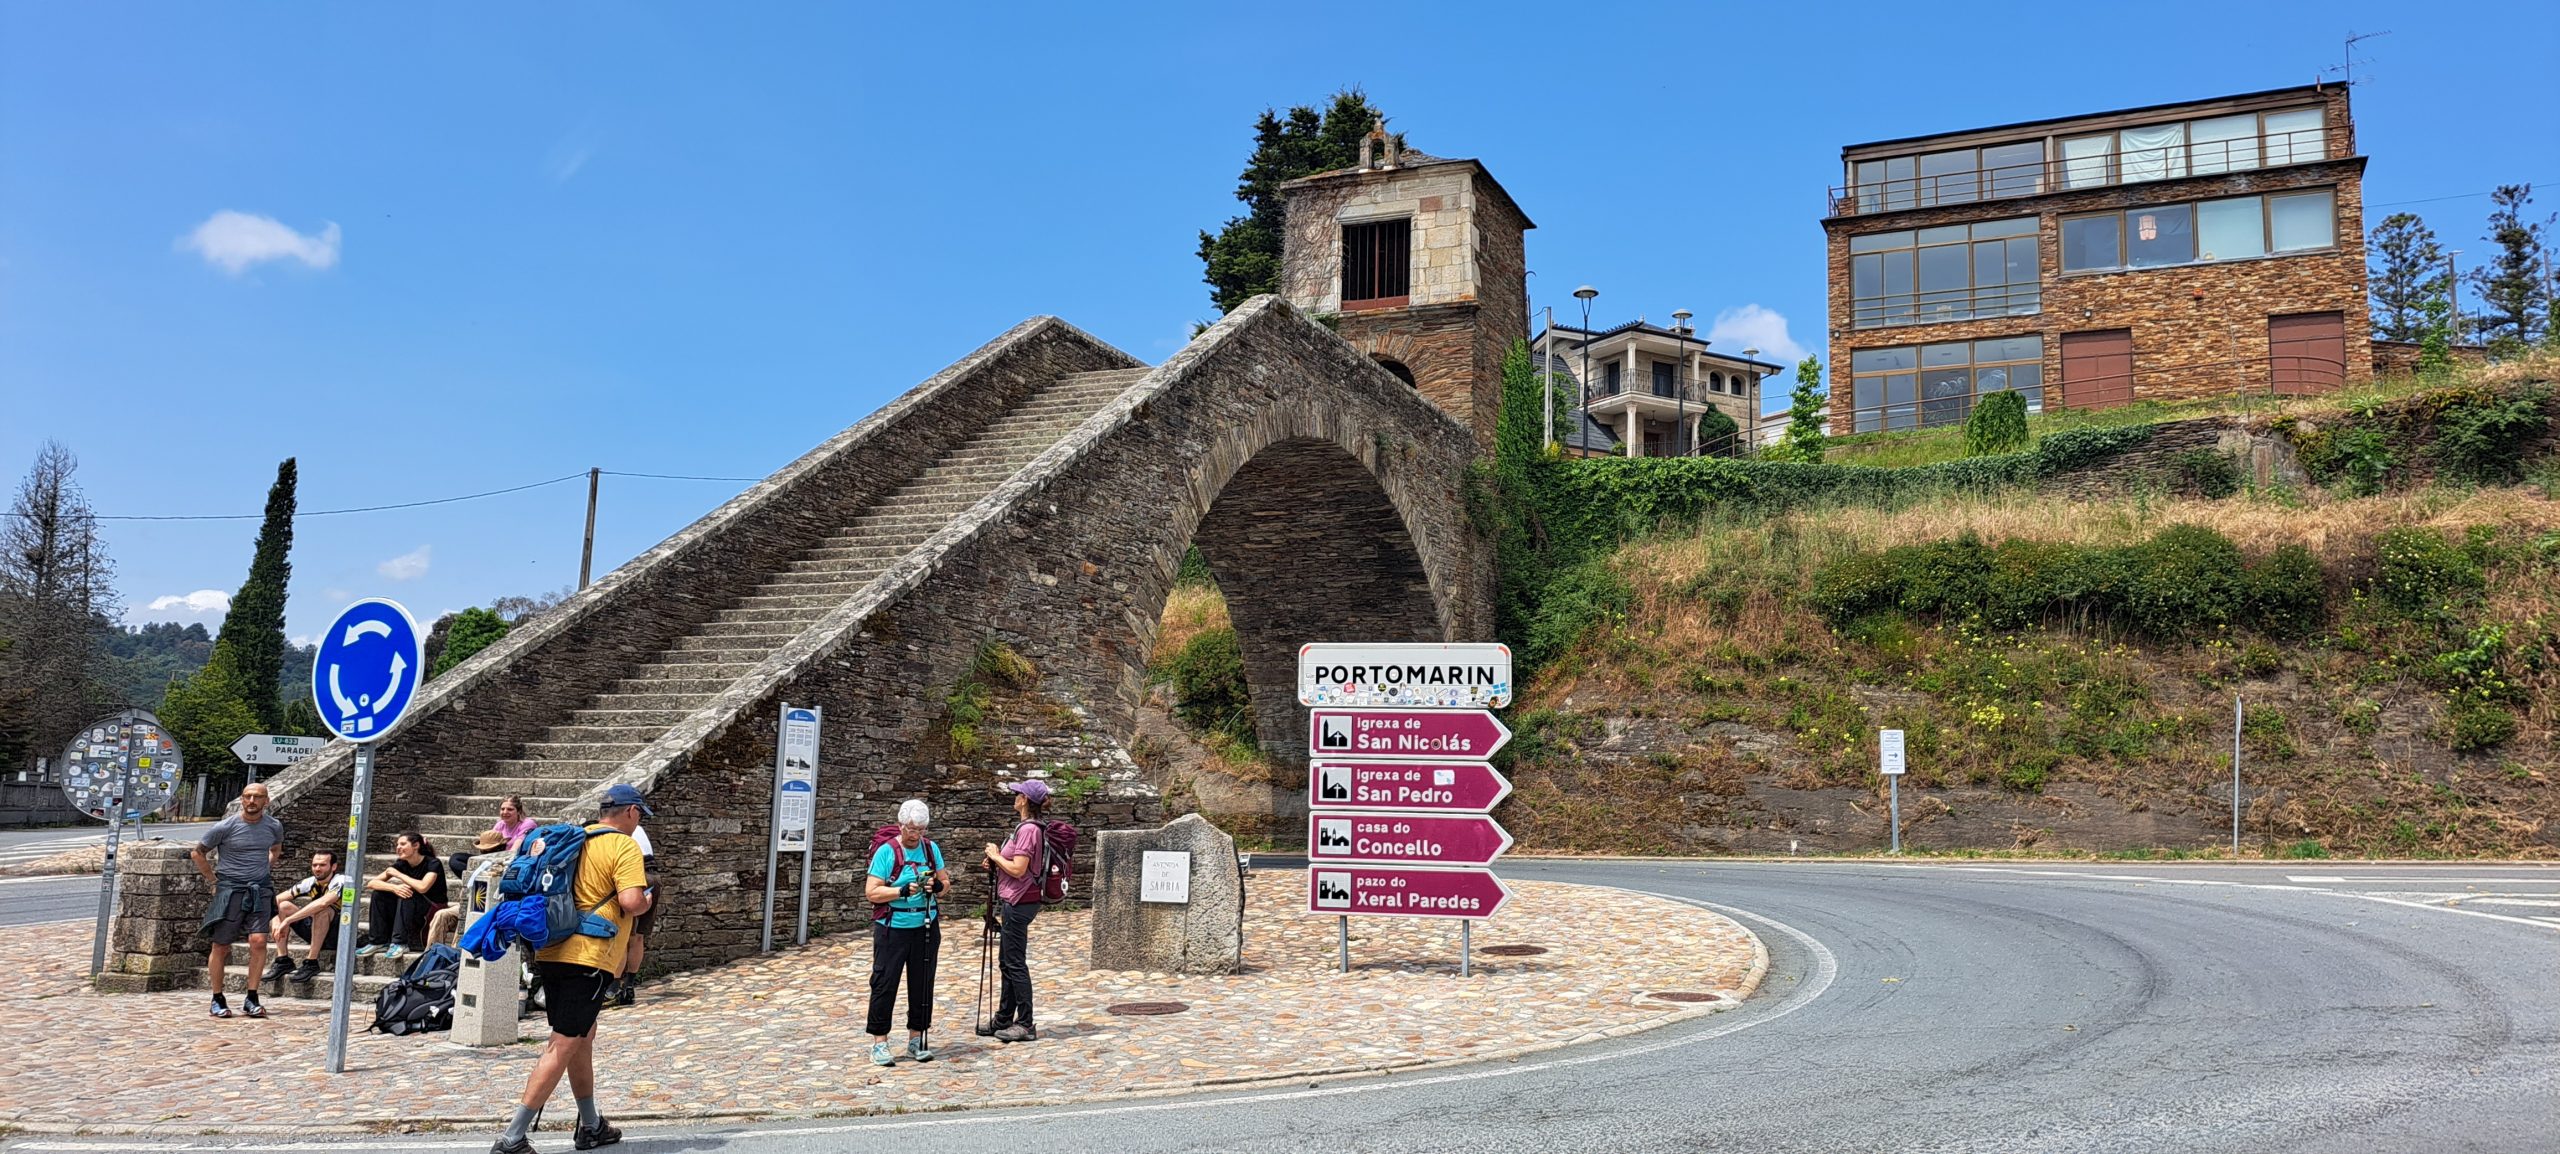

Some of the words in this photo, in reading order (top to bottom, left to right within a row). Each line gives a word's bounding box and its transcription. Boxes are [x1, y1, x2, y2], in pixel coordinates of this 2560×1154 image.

[1315, 665, 1495, 685] PORTOMARIN
[1357, 717, 1399, 731] igrexa
[1404, 718, 1421, 729] de
[1357, 734, 1392, 749] San
[1357, 769, 1399, 783] igrexa
[1404, 770, 1421, 781] de
[1357, 786, 1392, 802] San
[1399, 786, 1453, 803] Pedro
[1357, 823, 1388, 833] casa
[1393, 822, 1411, 834] do
[1356, 838, 1442, 856] Concello
[1357, 877, 1387, 888] pazo
[1390, 876, 1407, 887] do
[1357, 891, 1403, 907] Xeral
[1408, 893, 1480, 909] Paredes
